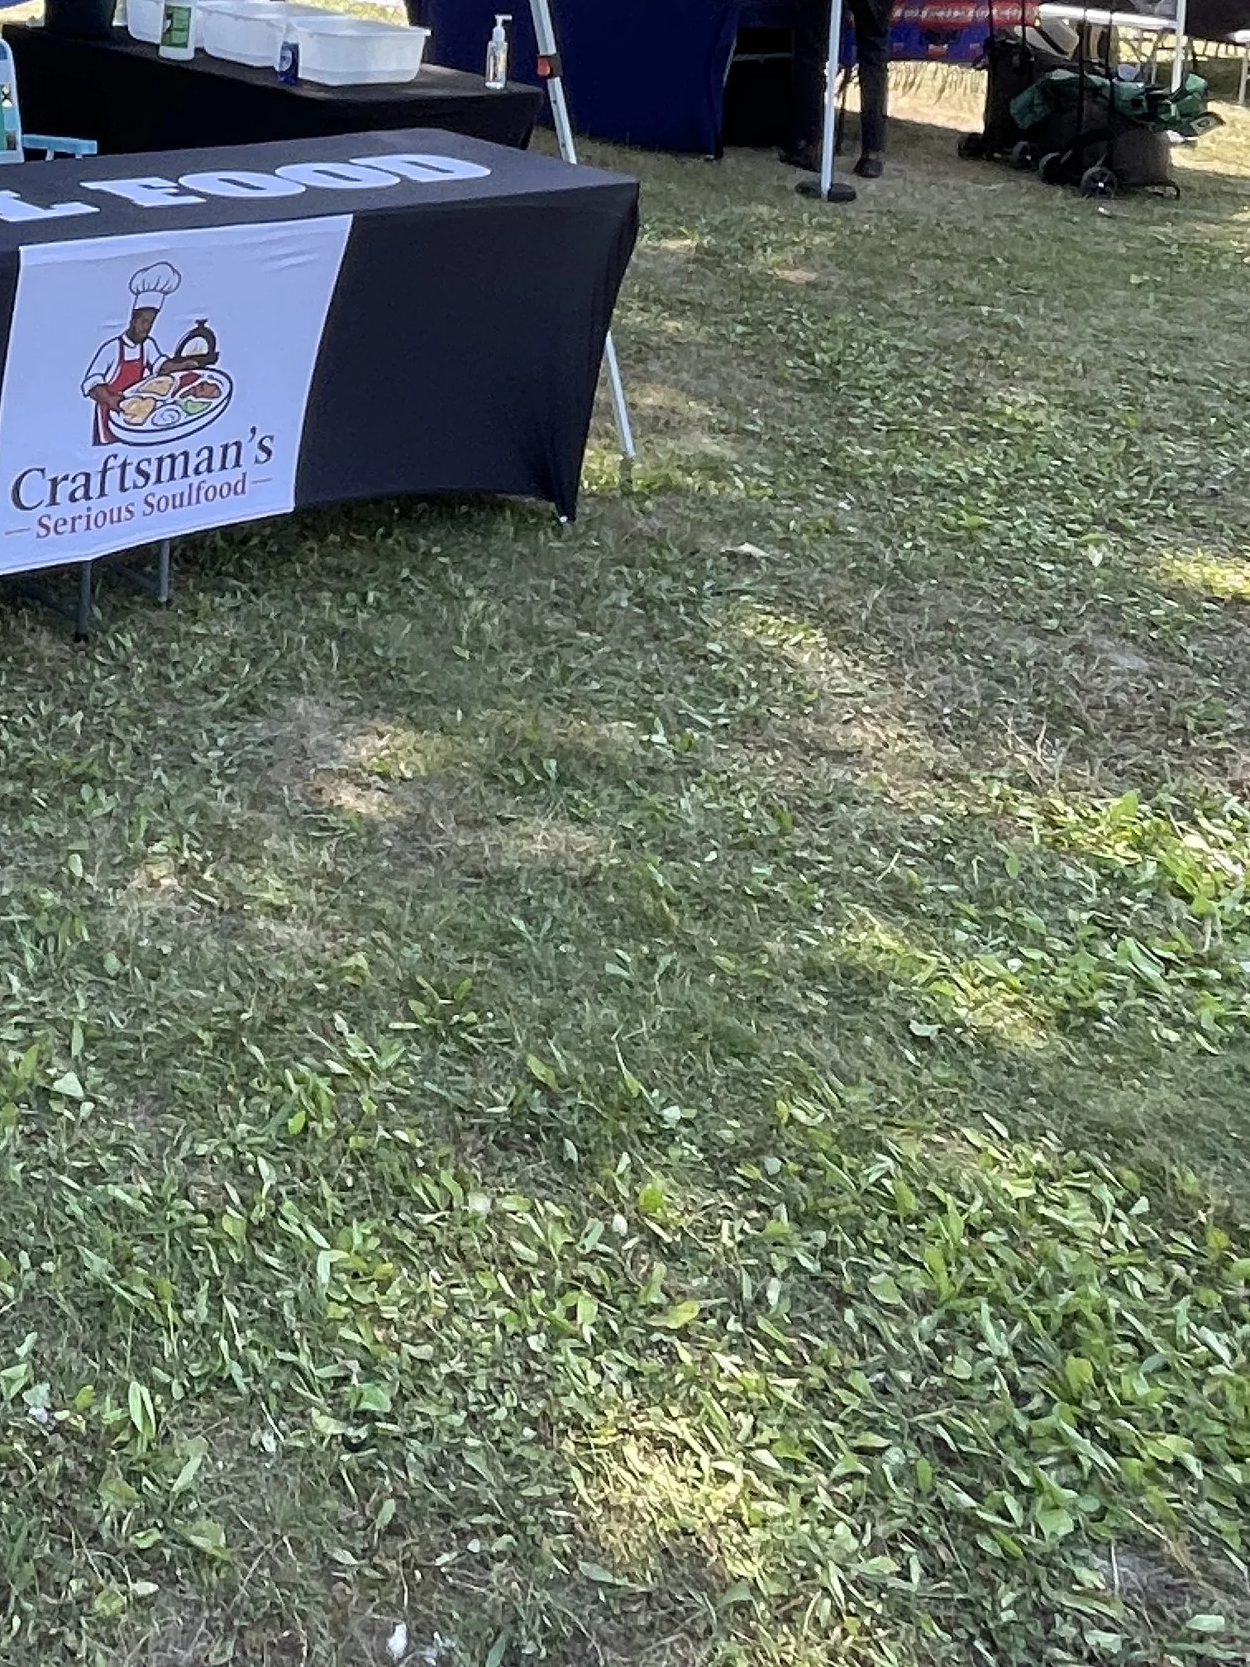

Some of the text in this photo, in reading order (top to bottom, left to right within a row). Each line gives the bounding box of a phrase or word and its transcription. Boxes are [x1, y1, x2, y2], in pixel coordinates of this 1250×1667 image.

[80, 153, 493, 209] FOOD
[10, 425, 276, 513] Craftsman's
[35, 471, 249, 540] Serious Soulfood
